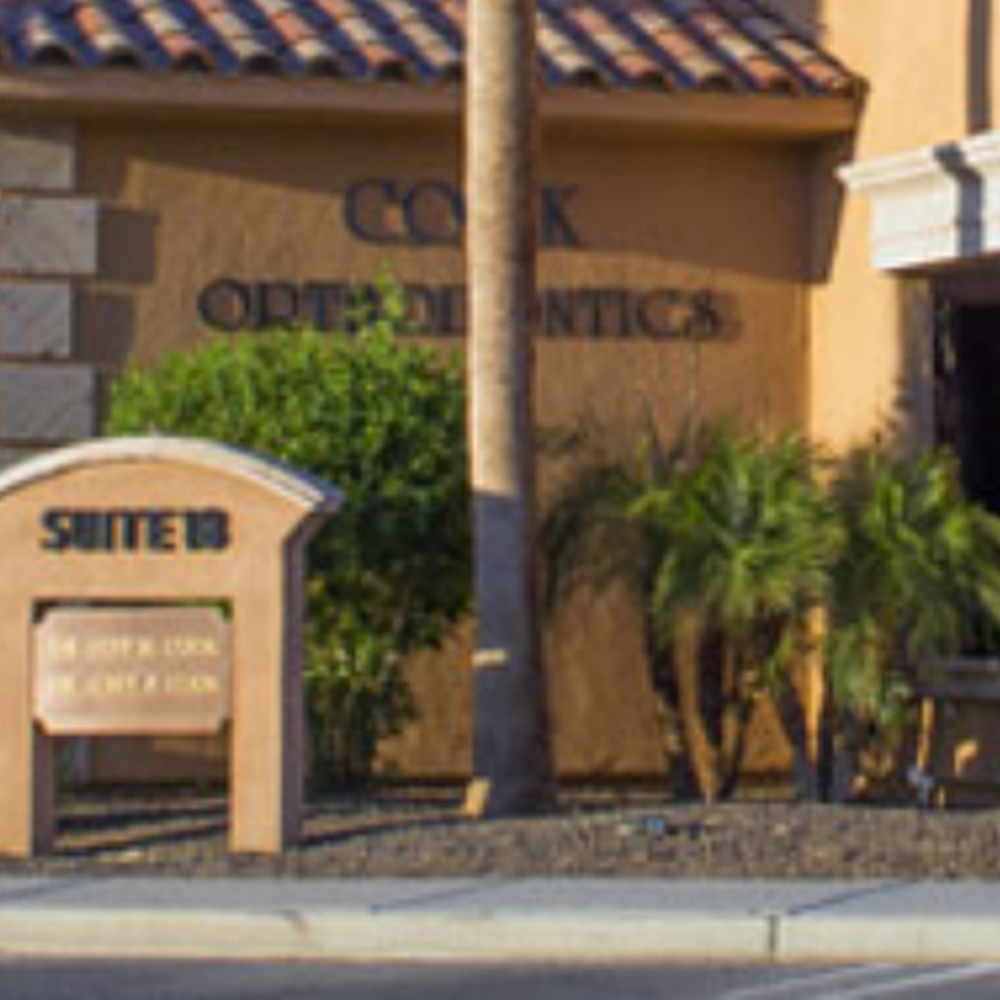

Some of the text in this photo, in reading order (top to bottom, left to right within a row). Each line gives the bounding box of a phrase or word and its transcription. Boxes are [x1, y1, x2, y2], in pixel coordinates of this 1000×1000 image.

[343, 177, 582, 249] COK
[198, 278, 728, 341] ORTHONTICS
[41, 508, 177, 551] SUITE
